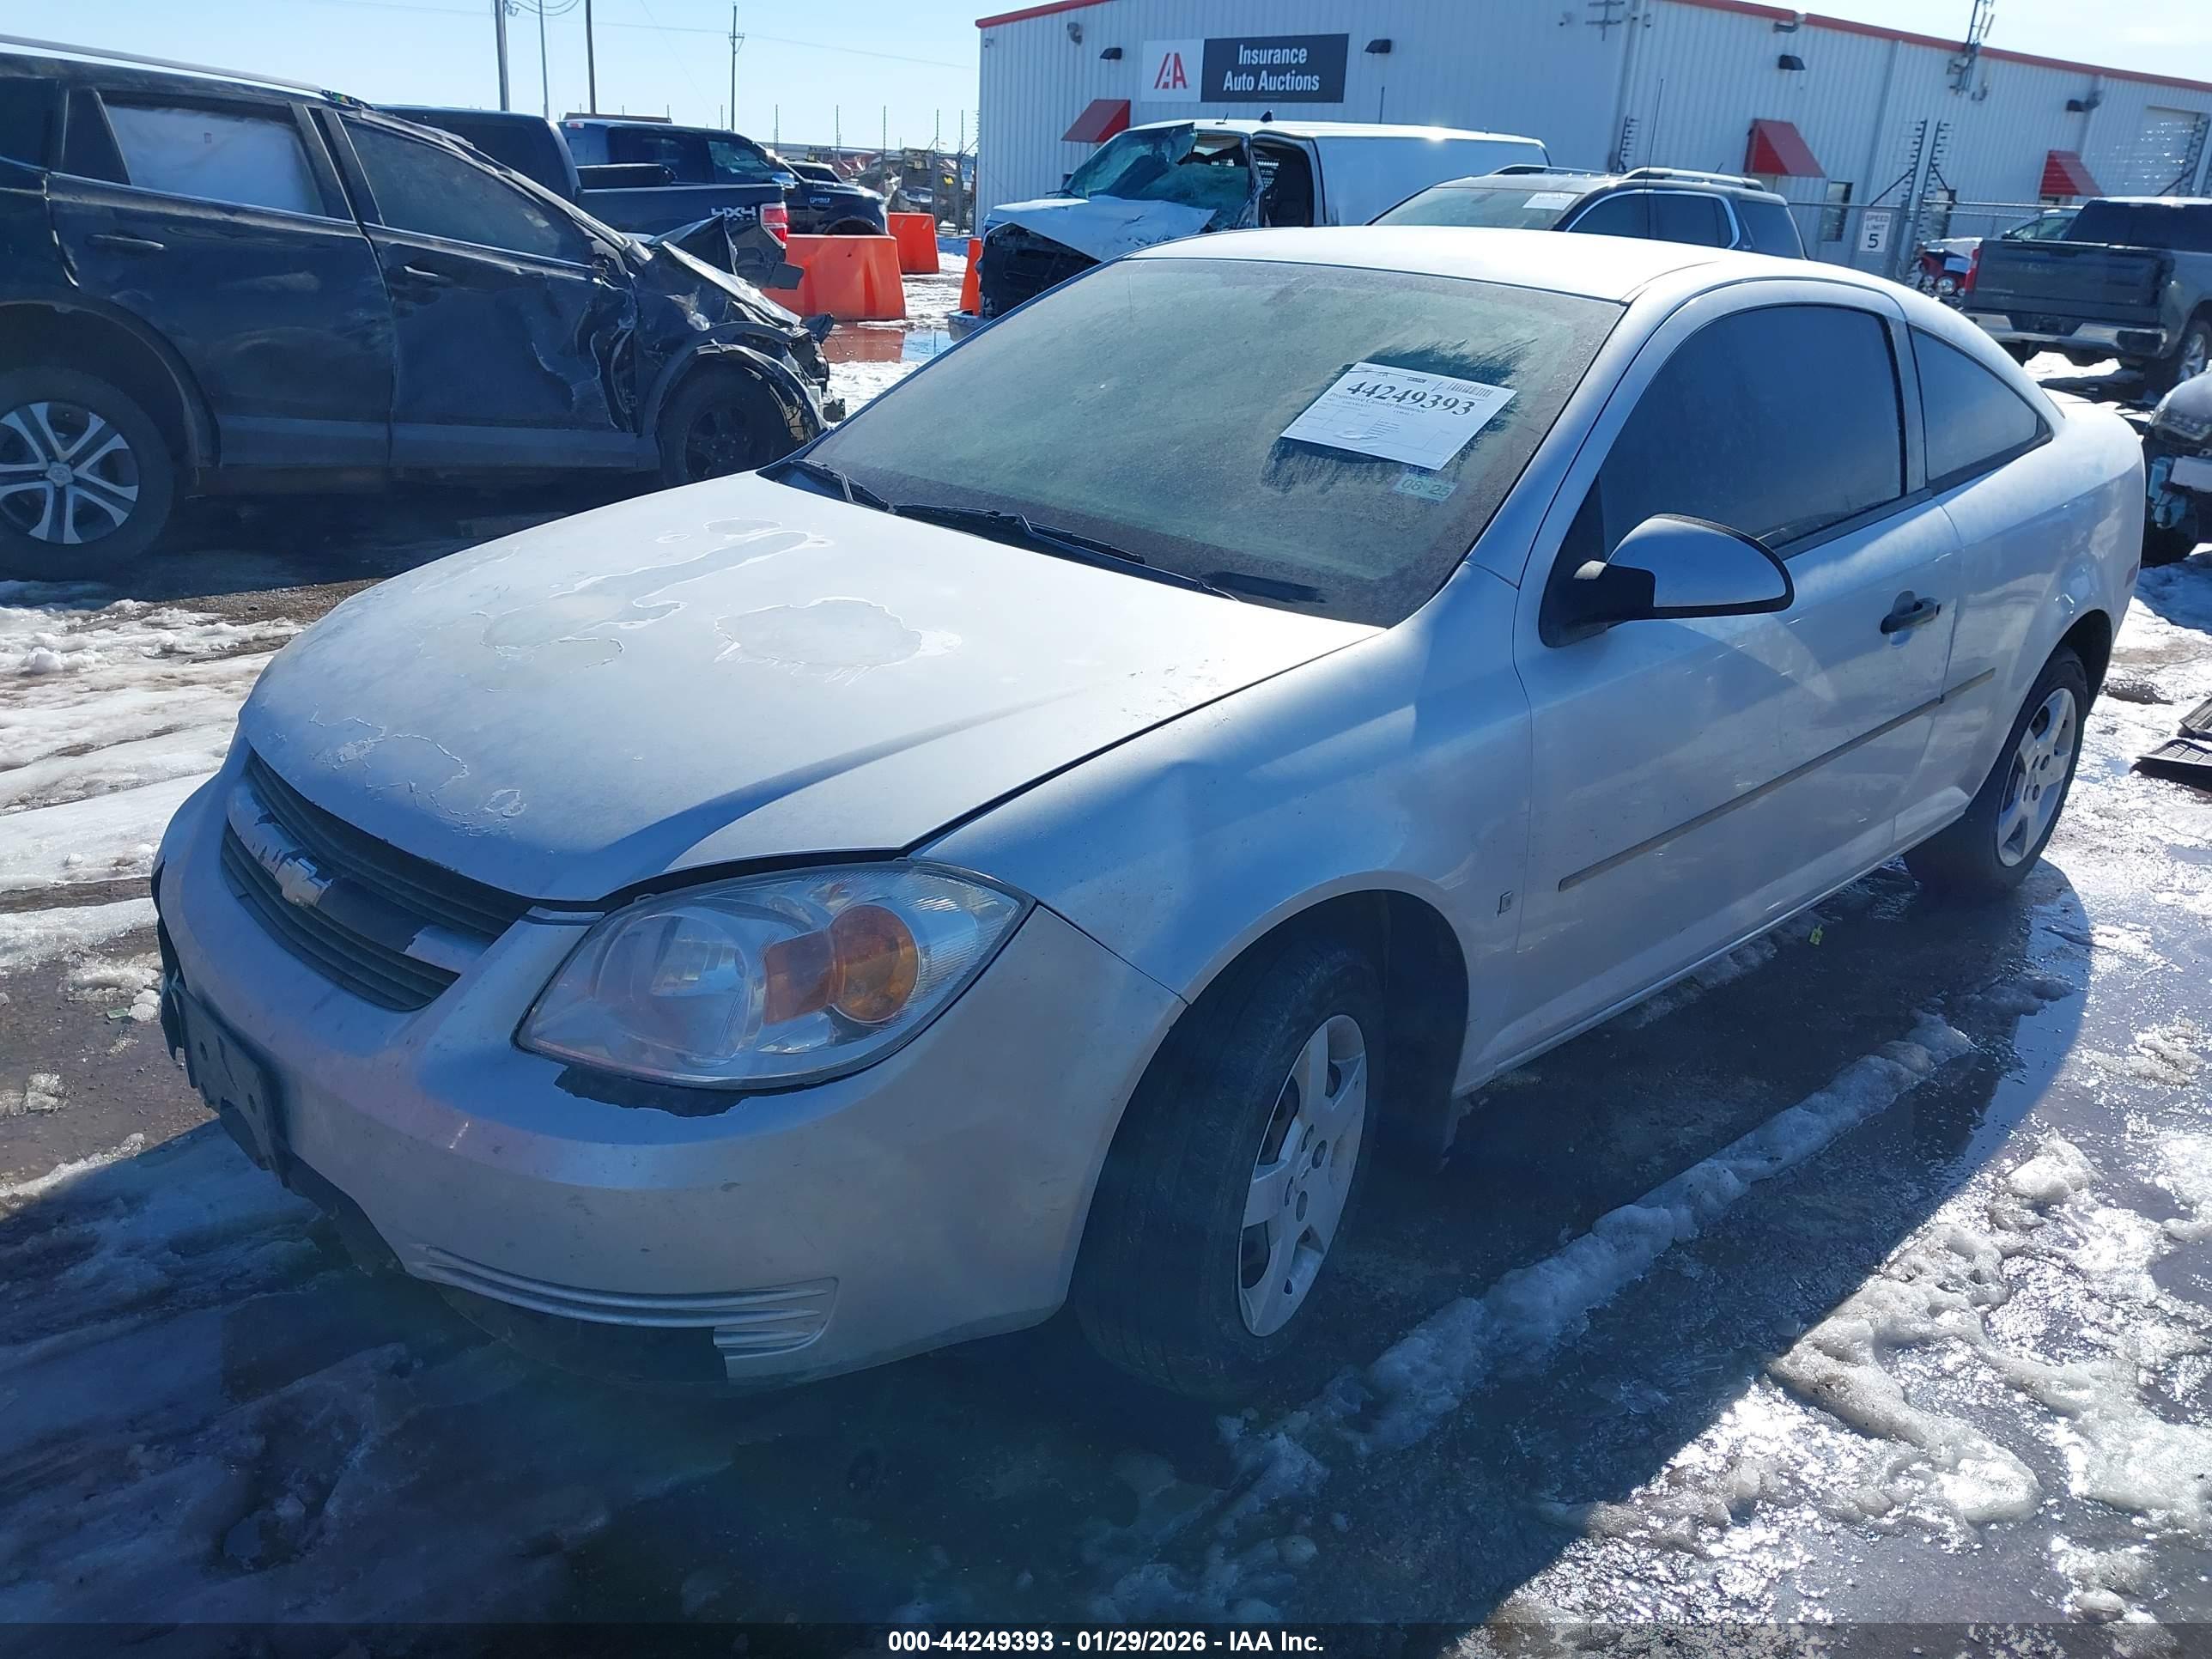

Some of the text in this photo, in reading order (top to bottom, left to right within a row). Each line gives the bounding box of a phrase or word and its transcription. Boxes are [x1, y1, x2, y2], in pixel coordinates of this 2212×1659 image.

[1238, 44, 1308, 65] Insurance
[1223, 70, 1320, 92] Auto Auctions
[1867, 234, 1879, 248] 5
[1346, 381, 1475, 416] 44249393
[1401, 479, 1450, 496] 08 25
